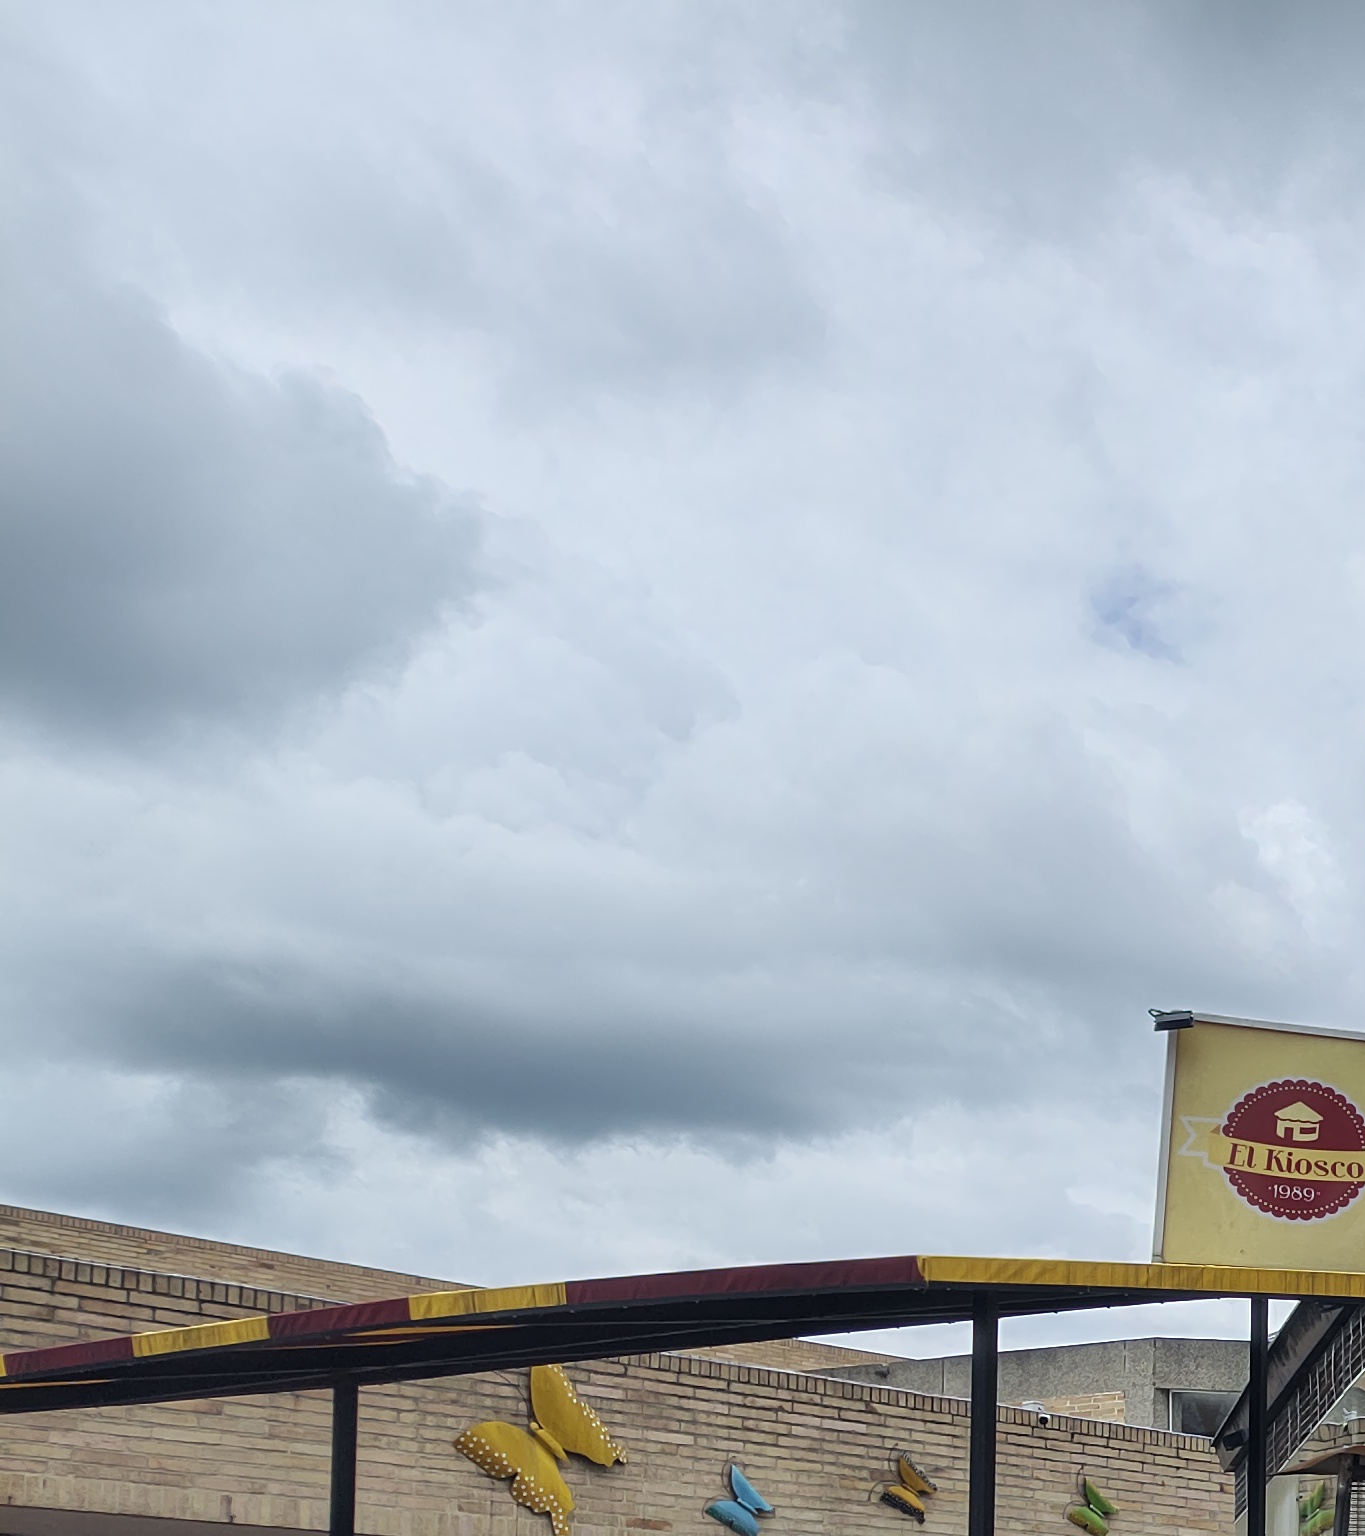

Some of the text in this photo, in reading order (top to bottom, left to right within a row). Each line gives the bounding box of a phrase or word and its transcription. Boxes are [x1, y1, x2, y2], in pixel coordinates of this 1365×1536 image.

[1226, 1143, 1364, 1178] El Kiosco
[1273, 1184, 1315, 1202] 1989
